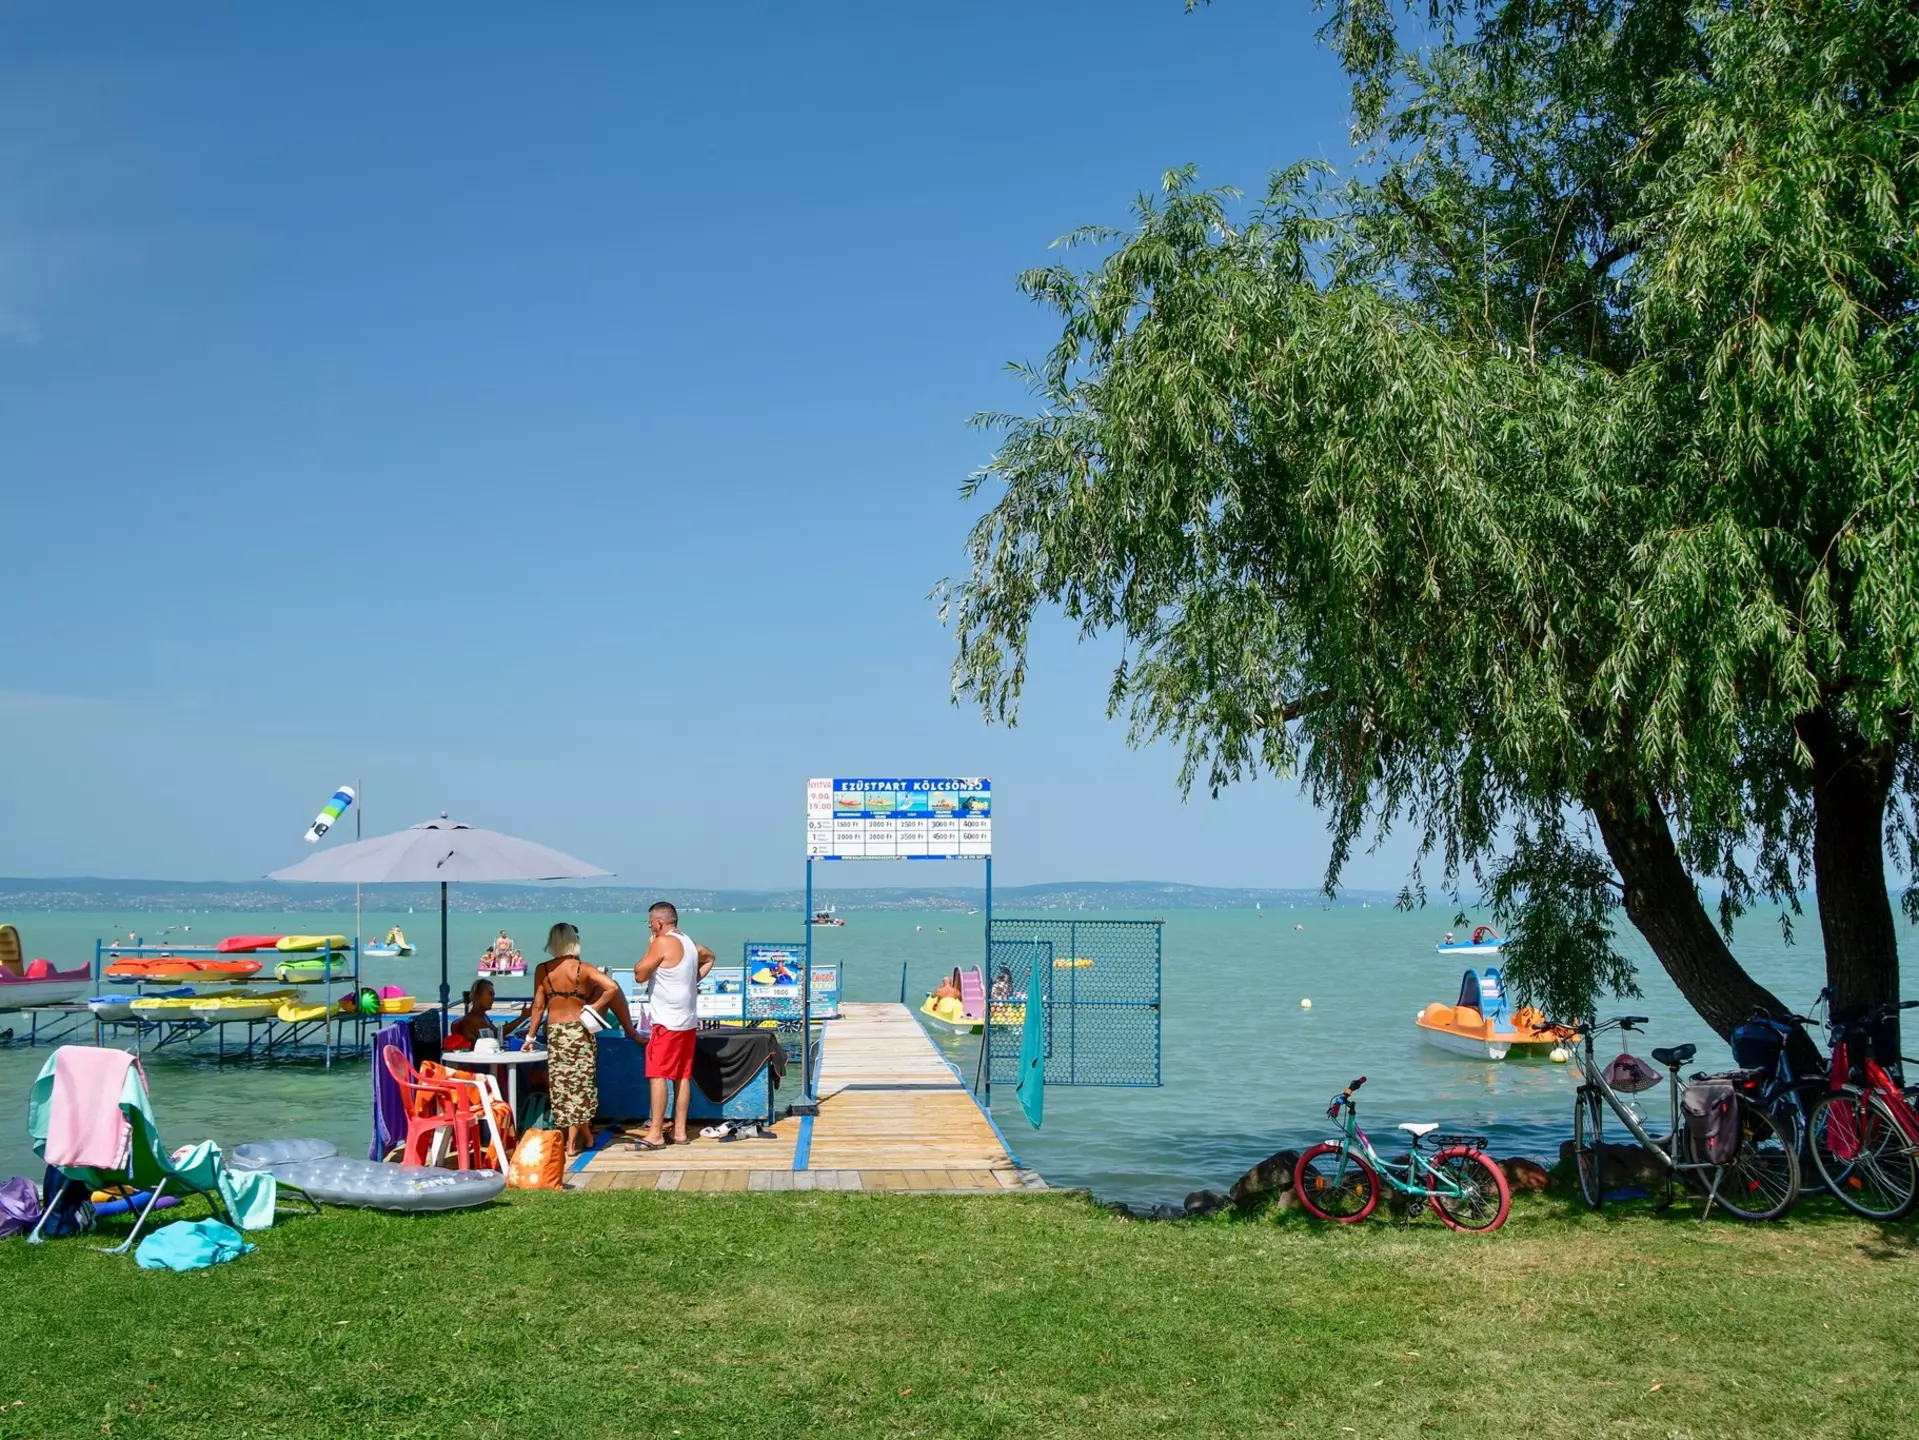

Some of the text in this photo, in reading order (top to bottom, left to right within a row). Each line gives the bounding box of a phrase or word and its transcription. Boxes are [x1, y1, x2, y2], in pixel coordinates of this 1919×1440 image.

[808, 781, 832, 789] NYITVA
[841, 780, 907, 791] EZÜSTPART
[808, 821, 822, 830] 0,5
[963, 820, 980, 828] 4000
